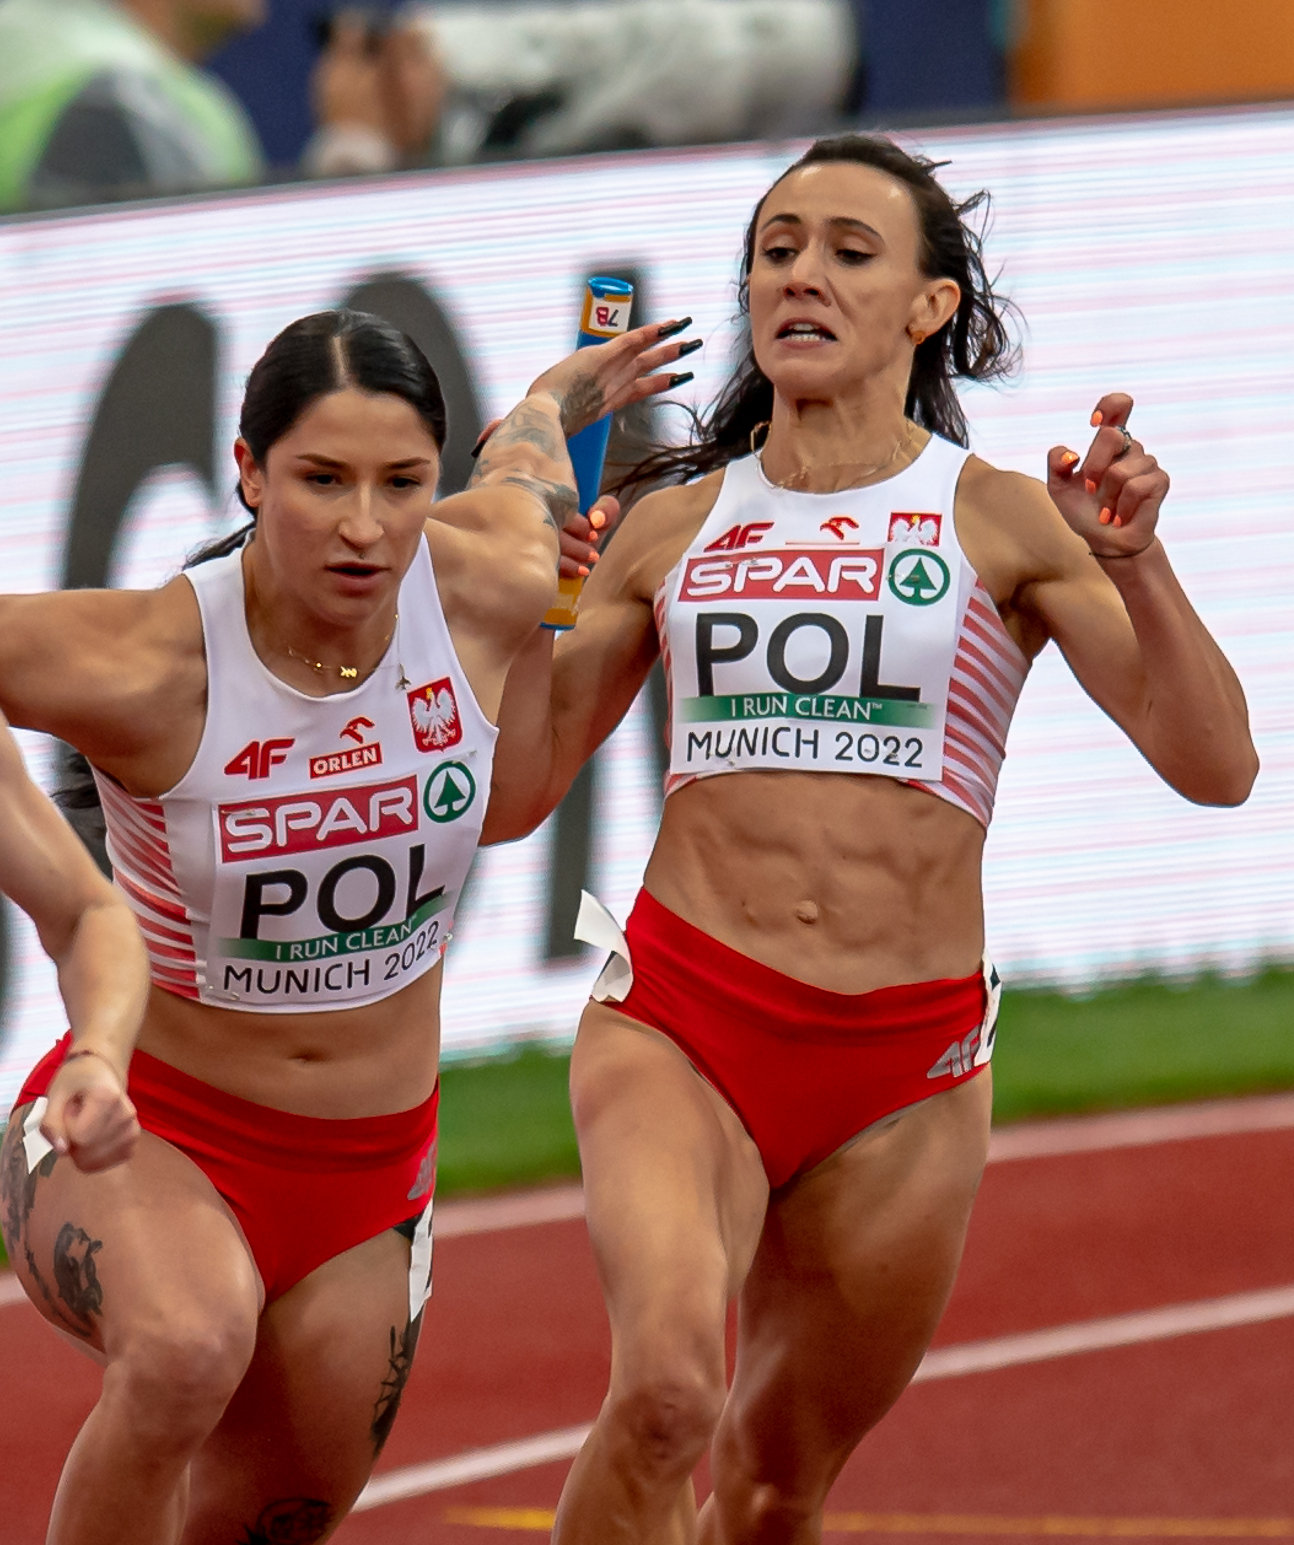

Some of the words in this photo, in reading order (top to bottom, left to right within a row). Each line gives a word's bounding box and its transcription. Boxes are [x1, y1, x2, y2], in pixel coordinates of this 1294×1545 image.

[686, 556, 878, 597] SPAR
[696, 612, 921, 702] POL
[730, 698, 737, 717] I
[743, 696, 788, 717] RUN
[312, 747, 378, 775] ORLEN
[686, 726, 819, 762] MUNICH
[834, 731, 923, 768] 2022
[225, 786, 413, 853] SPAR
[240, 844, 445, 939] POL
[223, 958, 370, 994] MUNICH
[384, 920, 439, 981] 2022
[275, 945, 282, 960] I
[290, 937, 339, 960] RUN
